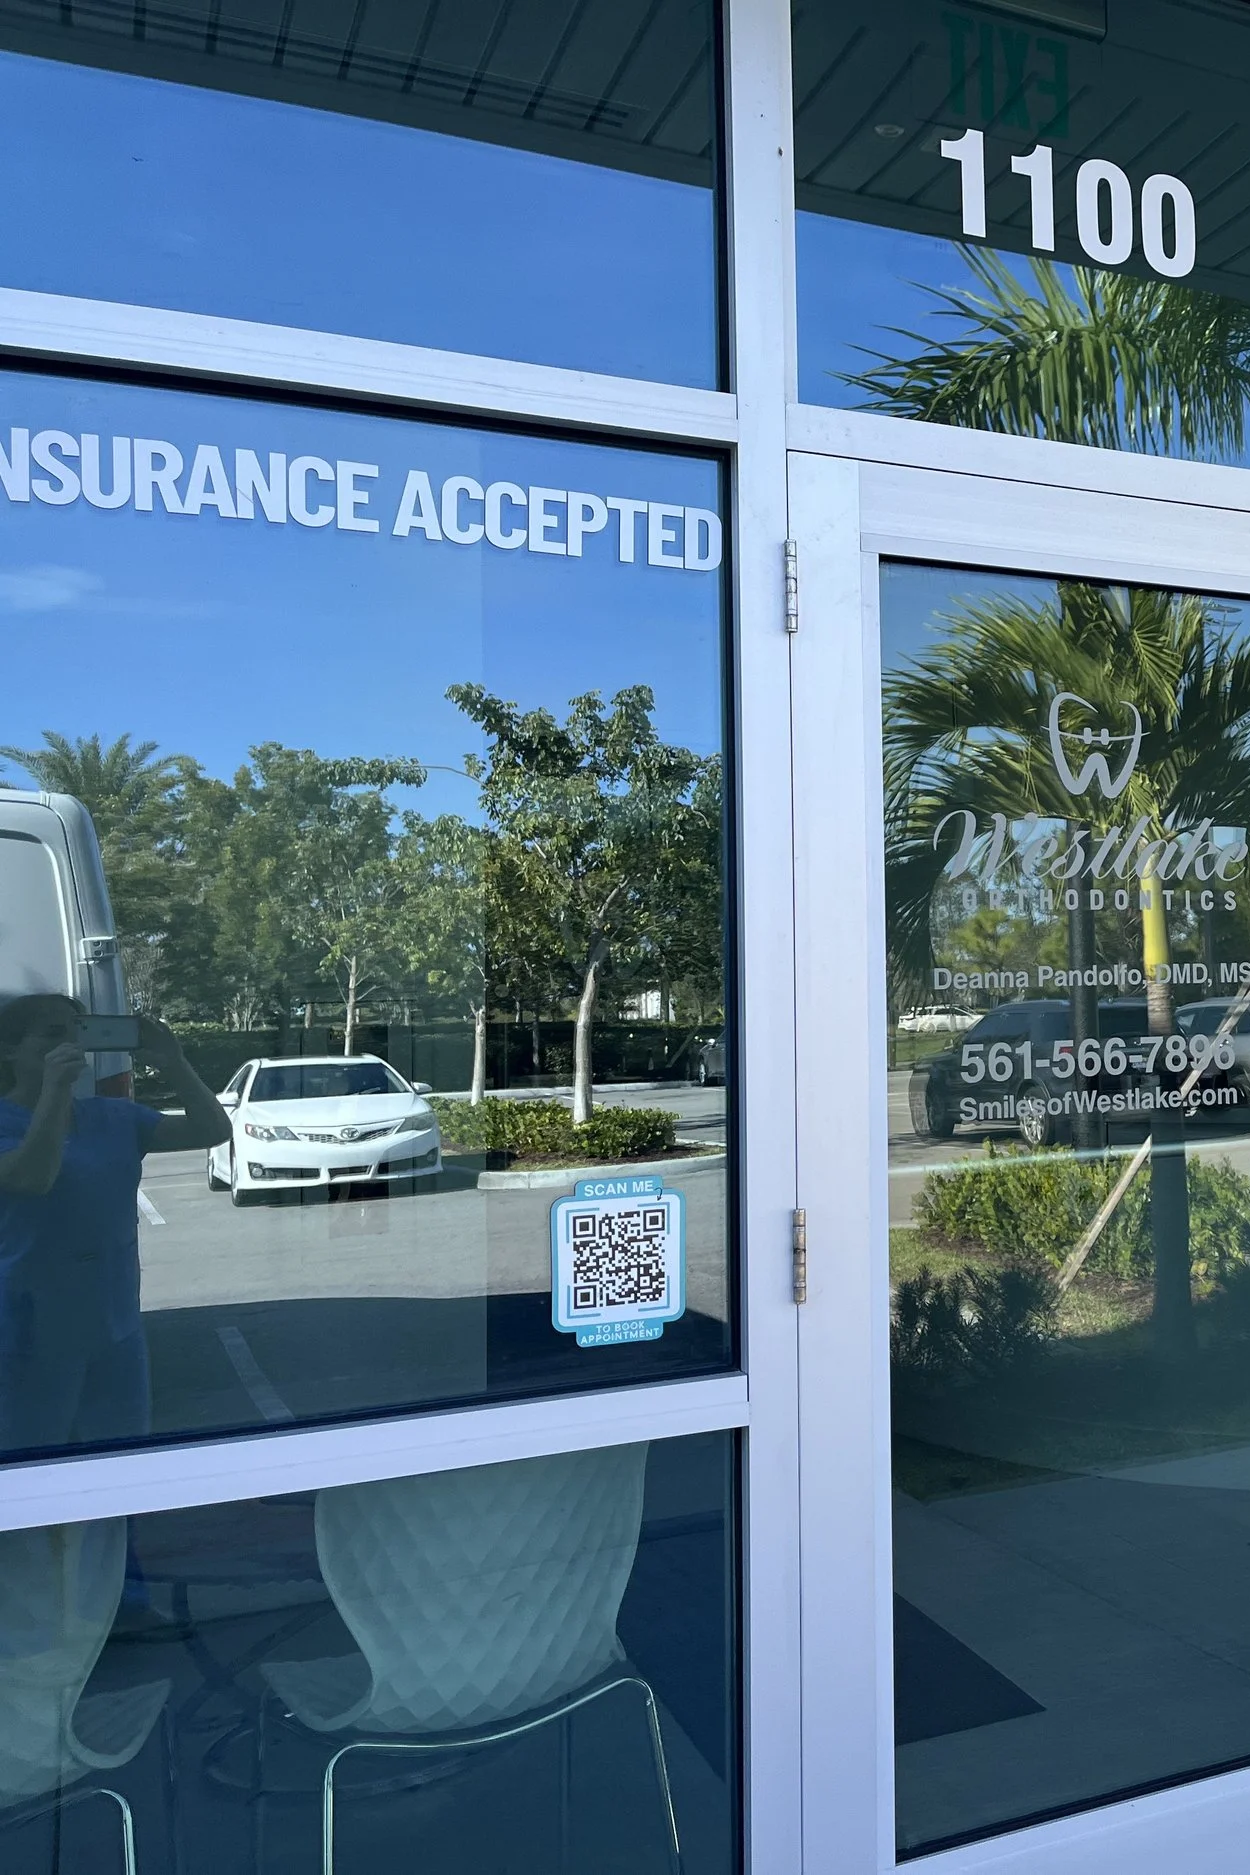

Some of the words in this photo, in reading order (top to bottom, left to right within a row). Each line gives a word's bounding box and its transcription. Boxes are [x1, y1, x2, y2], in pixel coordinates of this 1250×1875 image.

[941, 128, 1196, 278] 1100
[393, 470, 723, 571] ACCEPTED
[933, 808, 1249, 882] Westlake
[962, 888, 1237, 912] ORTHODONTICS
[933, 966, 1029, 990] Deanna
[1038, 963, 1146, 990] Pandolfo,
[1155, 962, 1212, 988] DMD,
[960, 1033, 1236, 1084] 561-566-7896
[959, 1085, 1238, 1122] SmilesofWestlake.com
[584, 1182, 627, 1197] SCAN
[633, 1180, 654, 1193] ME
[580, 1327, 661, 1345] APPOINTMENT
[596, 1324, 611, 1333] TO
[614, 1321, 646, 1332] BOOK
